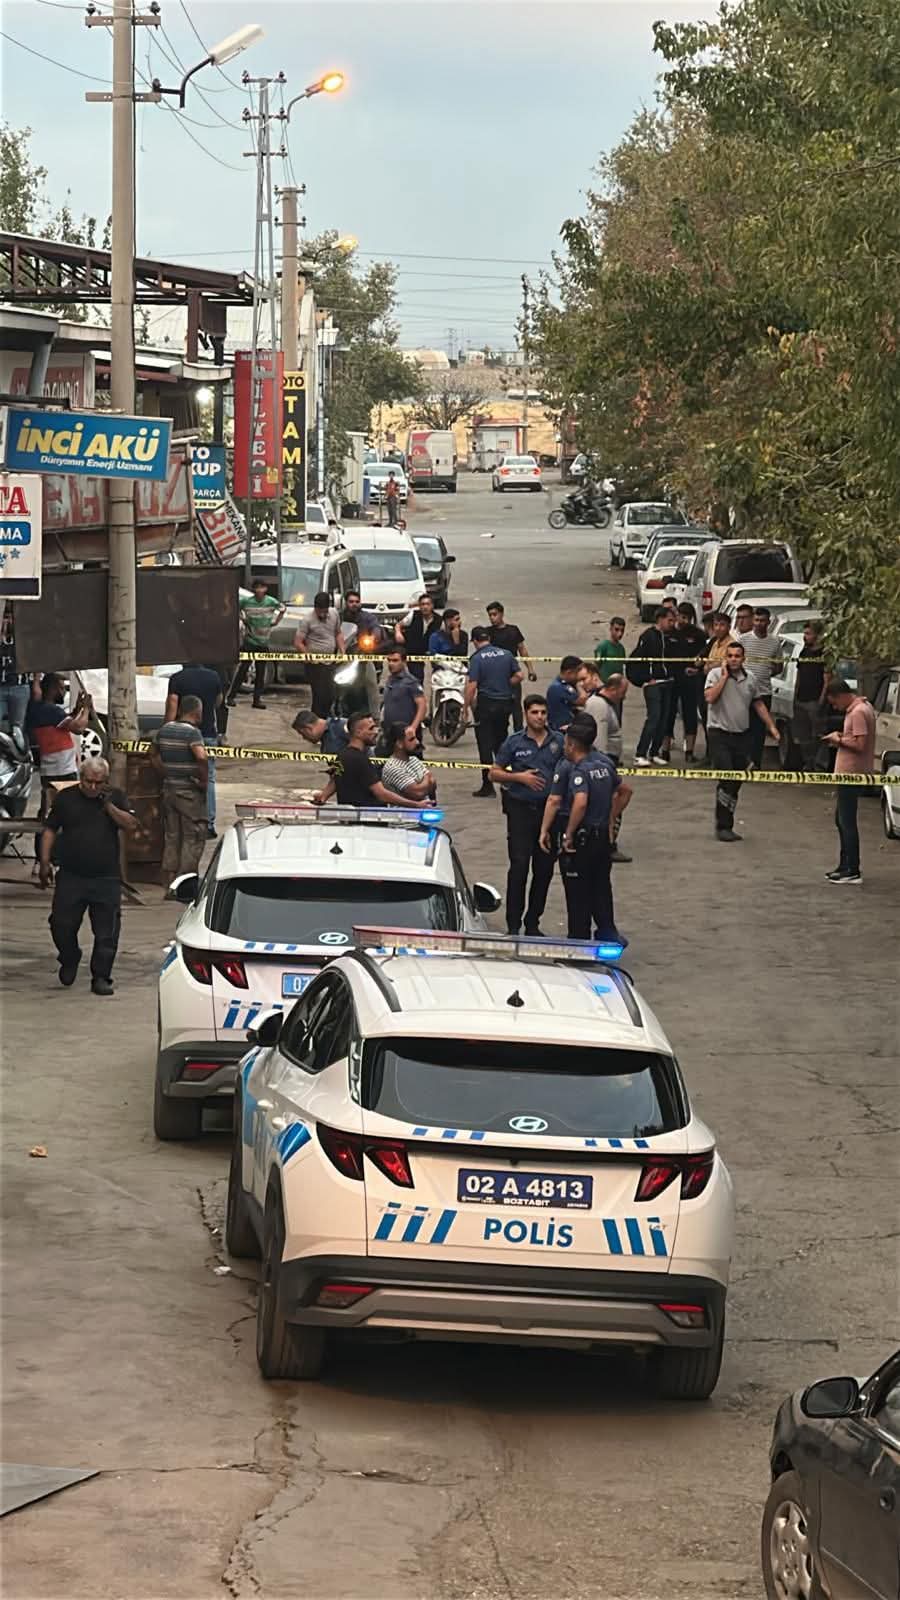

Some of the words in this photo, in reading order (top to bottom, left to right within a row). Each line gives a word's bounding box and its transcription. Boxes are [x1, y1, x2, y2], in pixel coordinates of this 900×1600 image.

[16, 418, 84, 456] İNCİ
[83, 427, 161, 462] AKÜ
[40, 455, 85, 467] Dünyanın
[86, 458, 115, 471] Enerji
[117, 463, 153, 472] Uzmanı
[466, 1175, 495, 1194] 02
[501, 1177, 519, 1196] A
[526, 1179, 584, 1199] 4813
[483, 1217, 575, 1248] POLİS
